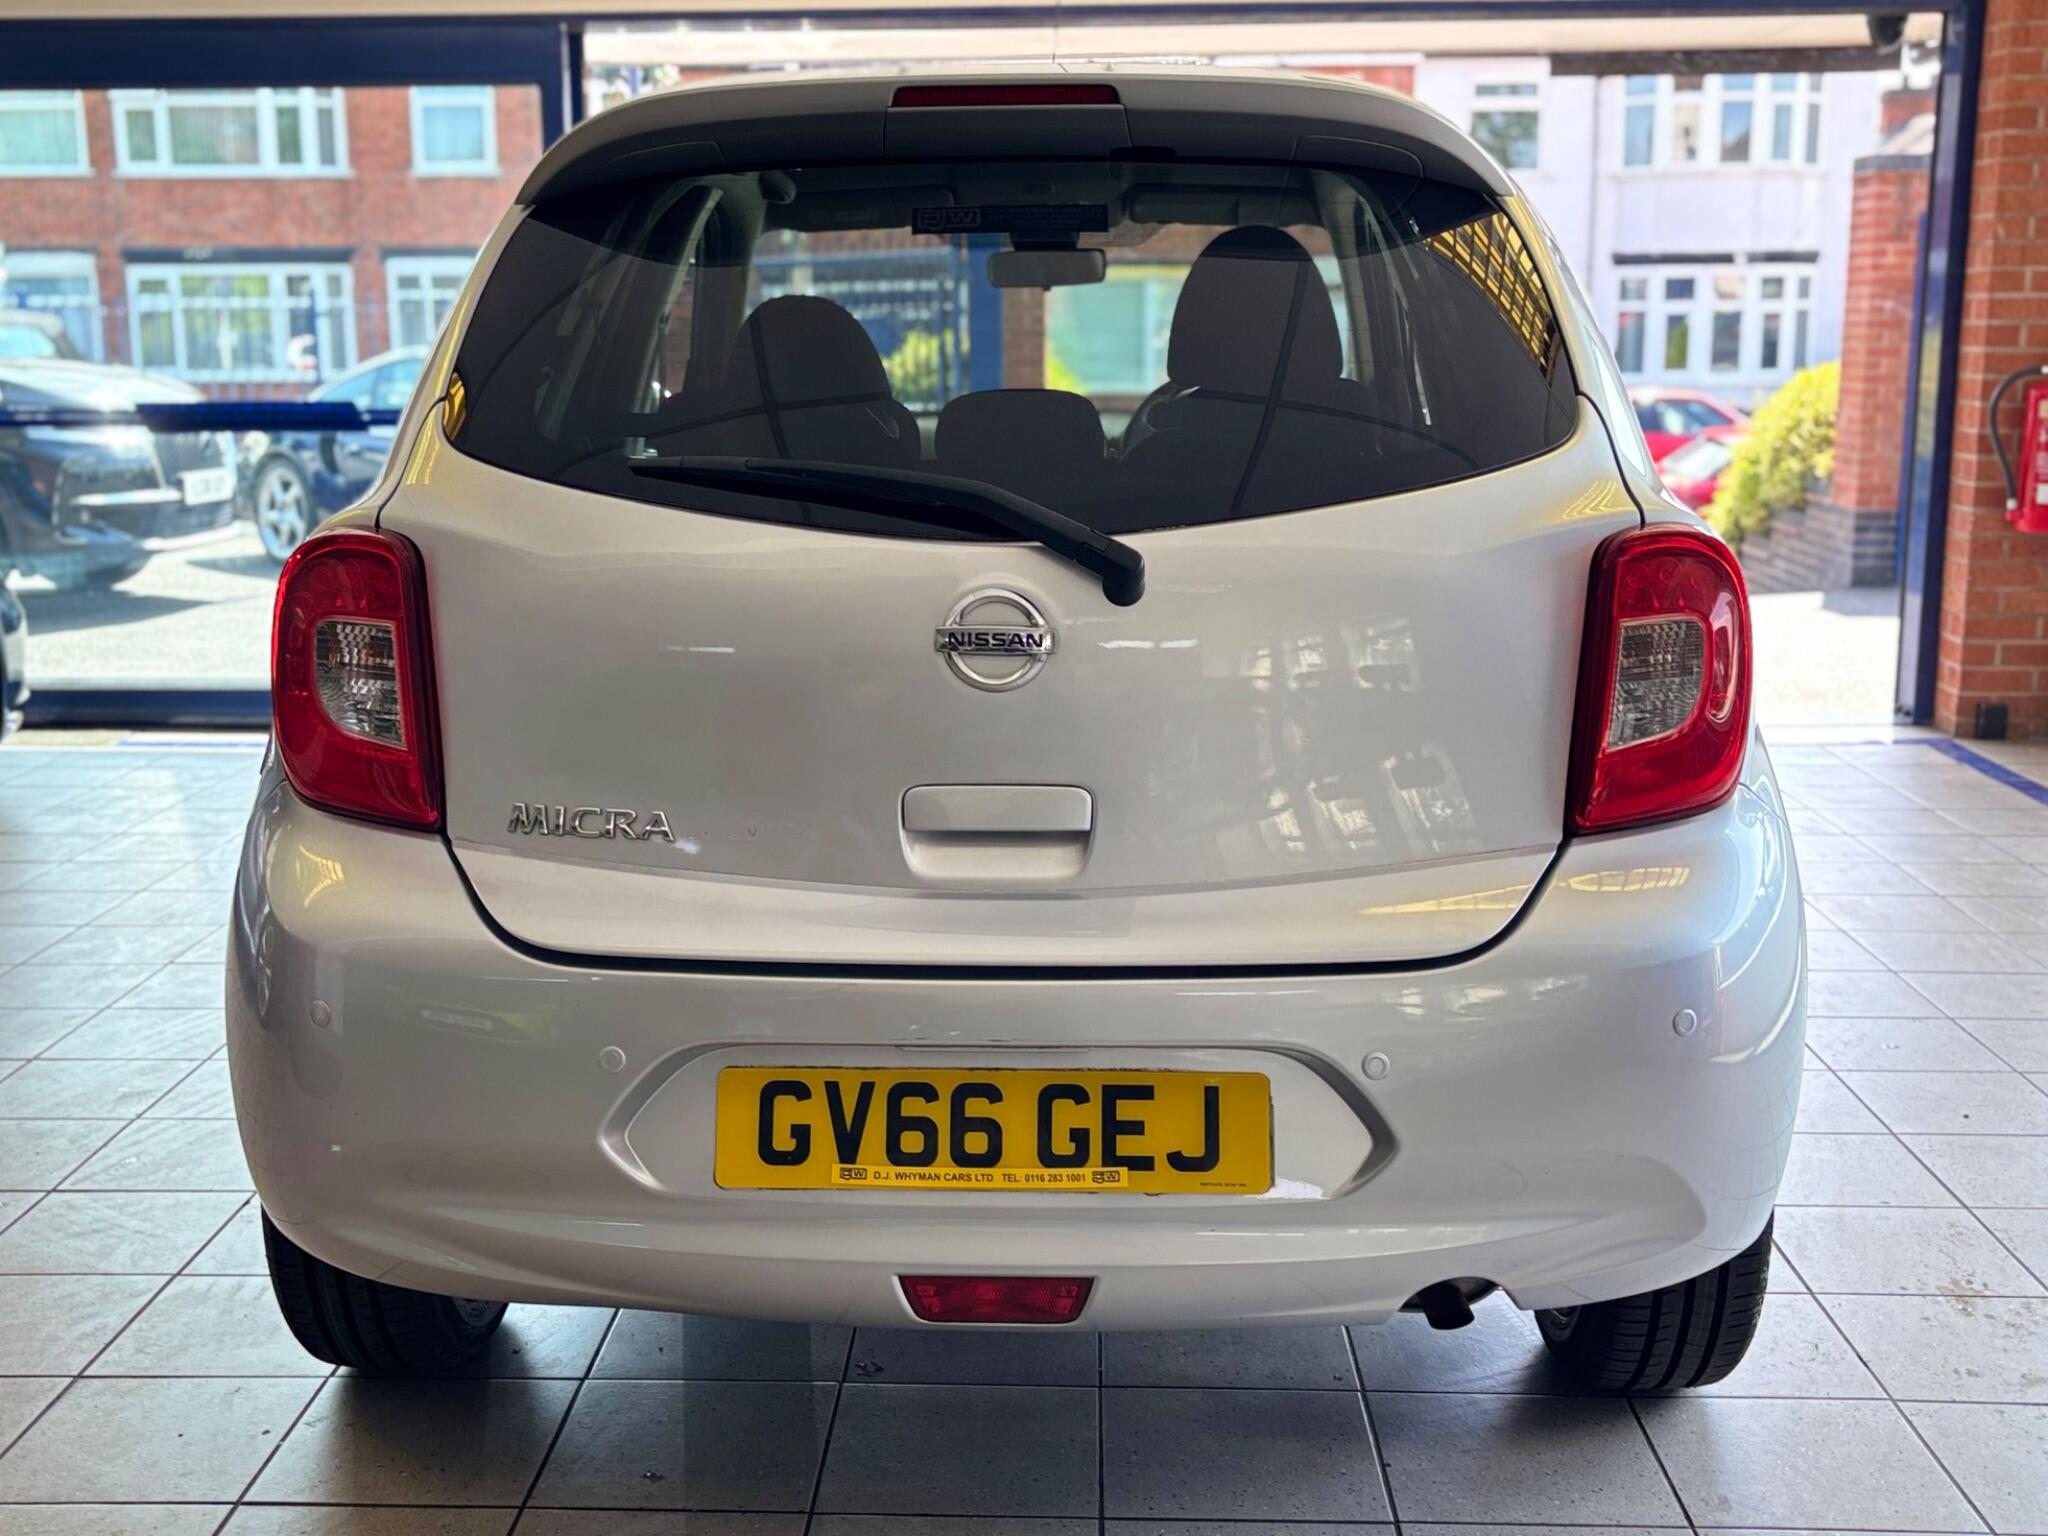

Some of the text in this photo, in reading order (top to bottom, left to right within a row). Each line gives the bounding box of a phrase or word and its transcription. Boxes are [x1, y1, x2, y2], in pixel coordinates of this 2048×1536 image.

[948, 631, 1044, 648] NISSAN
[507, 802, 675, 842] MICRA
[758, 1080, 1220, 1172] GV66 GEJ
[873, 1171, 891, 1180] D.J.
[895, 1172, 941, 1182] WHYMAN
[943, 1173, 973, 1182] CARS
[974, 1173, 994, 1182] LTD
[1024, 1173, 1046, 1182] 0116
[1047, 1173, 1064, 1182] 283
[1066, 1173, 1086, 1182] 1001
